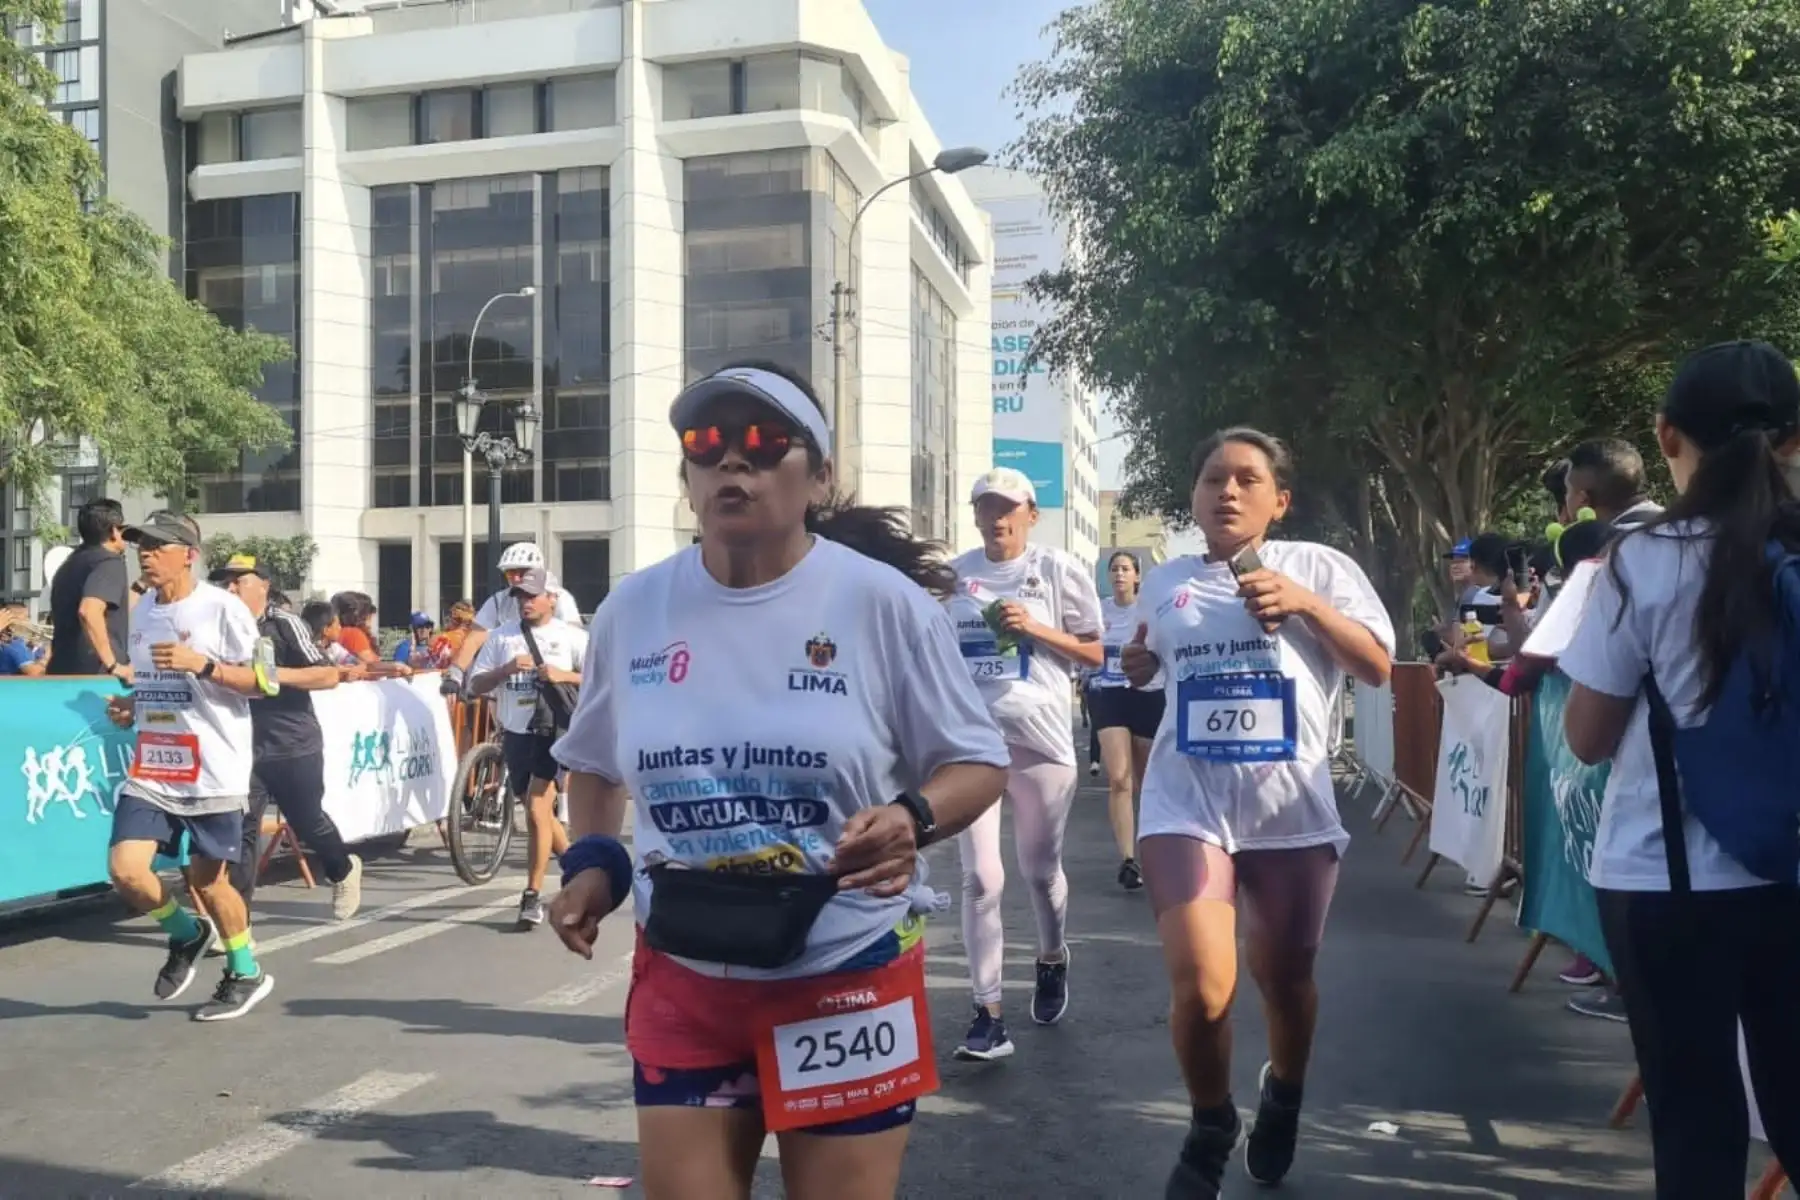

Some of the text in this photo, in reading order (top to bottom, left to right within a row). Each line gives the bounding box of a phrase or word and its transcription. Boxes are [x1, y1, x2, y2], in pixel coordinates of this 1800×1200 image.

[972, 661, 1004, 676] 735
[788, 674, 848, 696] LIMA
[1206, 709, 1257, 732] 670
[146, 750, 184, 766] 2133
[637, 742, 829, 773] Juntas y juntos
[654, 800, 818, 831] LA IGUALDAD
[836, 991, 877, 1009] LIMA
[794, 1021, 896, 1073] 2540
